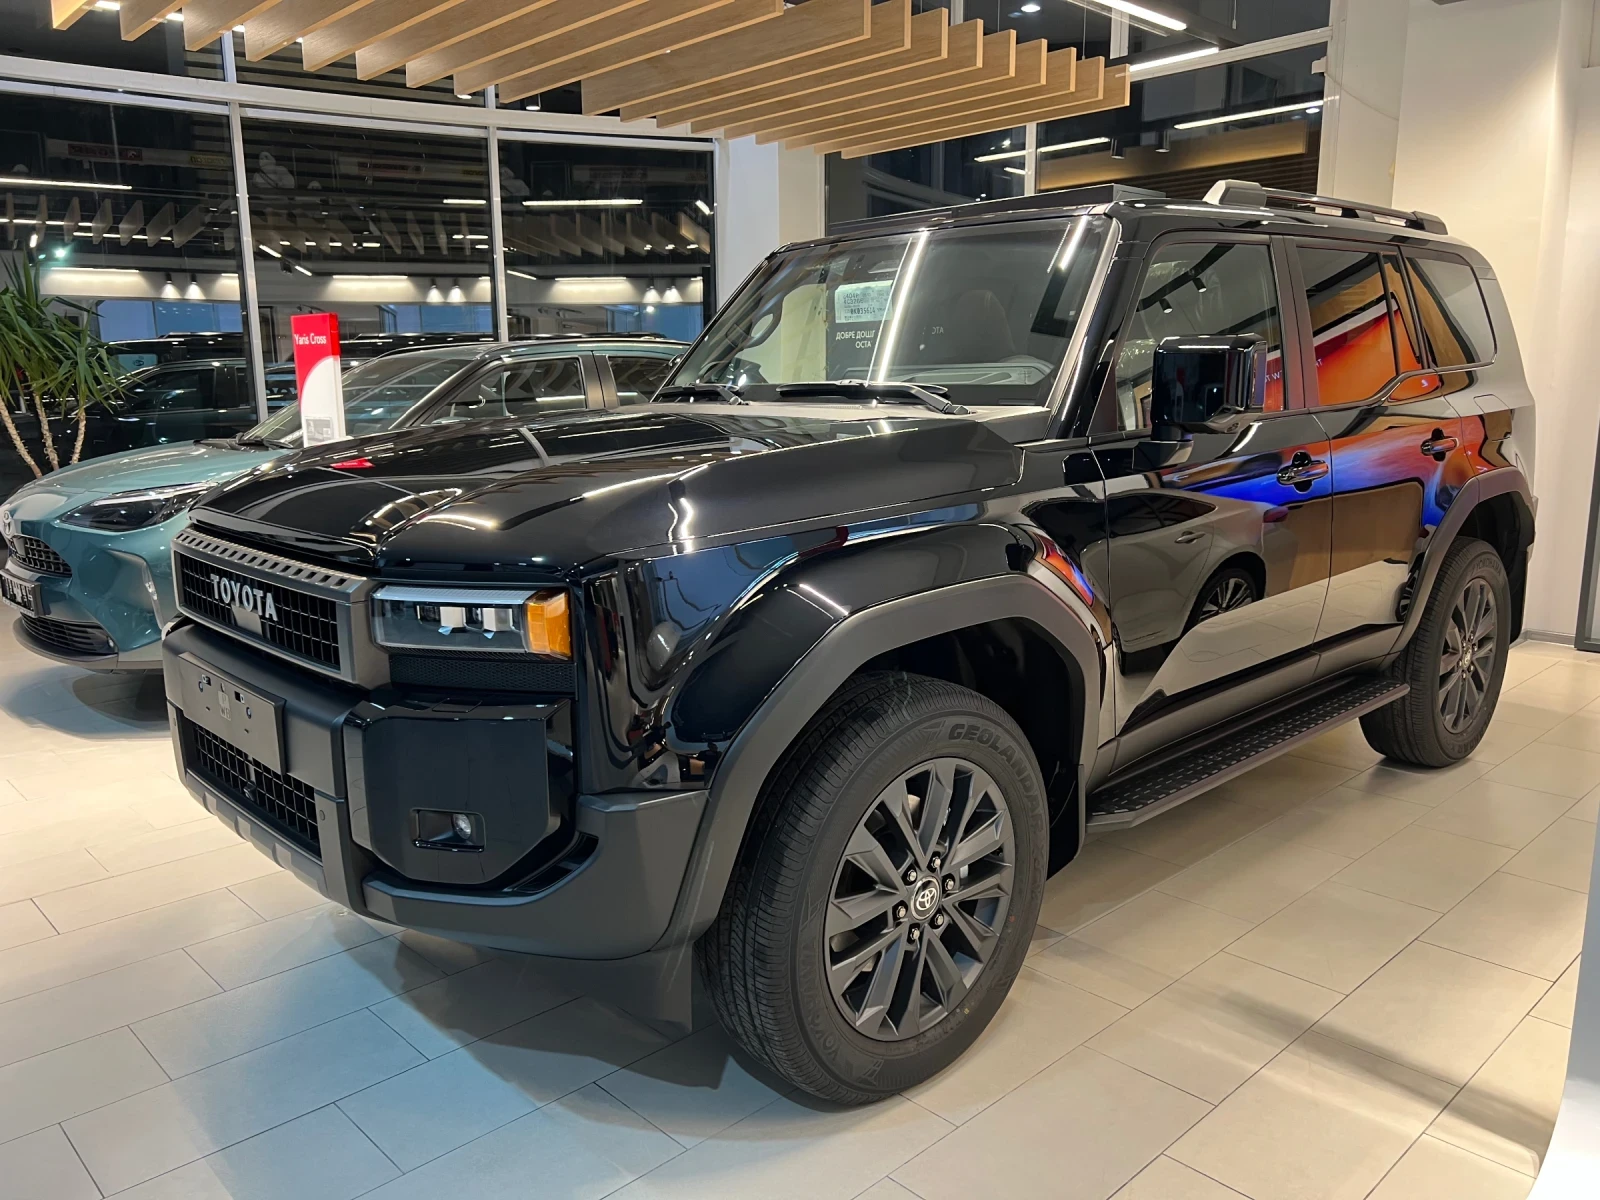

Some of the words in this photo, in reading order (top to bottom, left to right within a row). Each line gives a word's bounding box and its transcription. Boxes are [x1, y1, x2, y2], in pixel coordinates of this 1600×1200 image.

[293, 333, 310, 345] Yaris
[310, 332, 327, 345] Cross
[836, 331, 856, 341] ДОБРЕ
[855, 340, 873, 349] ОСТА
[210, 573, 279, 622] TOYOTA
[948, 723, 1045, 834] GEOLANDAR
